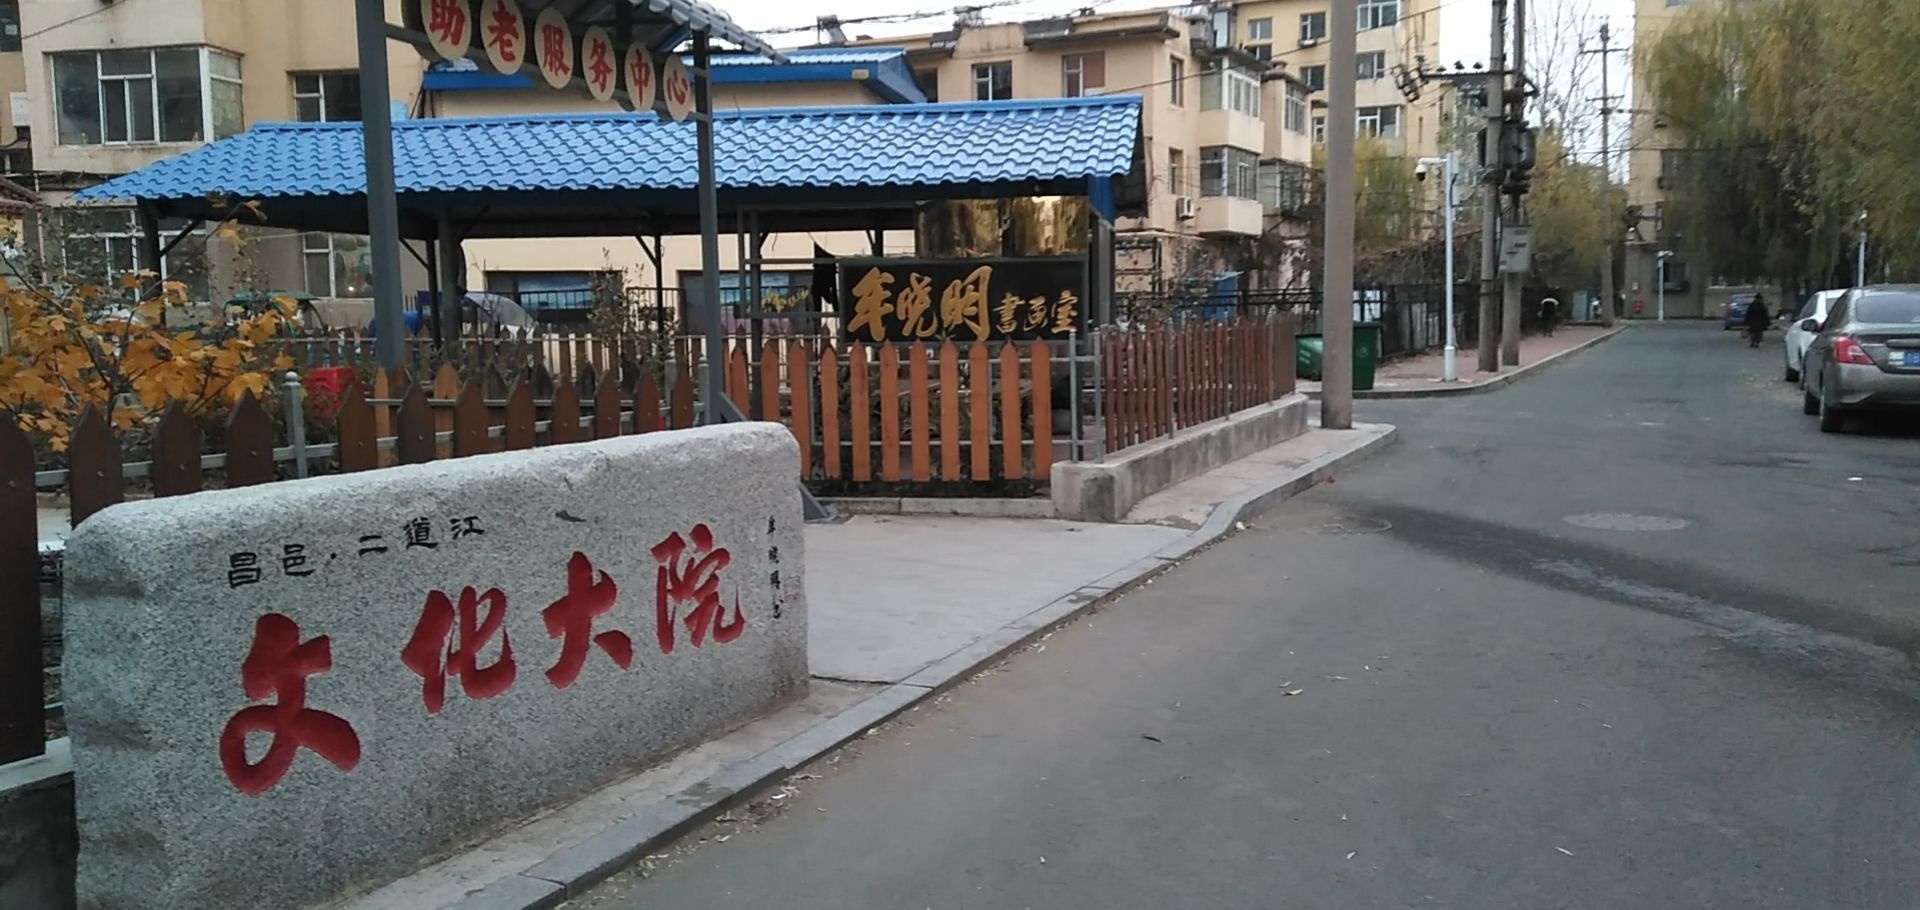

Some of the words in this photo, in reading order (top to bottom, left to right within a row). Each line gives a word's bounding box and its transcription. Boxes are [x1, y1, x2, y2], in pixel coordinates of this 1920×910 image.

[429, 0, 689, 105] 助老服务中心
[219, 522, 746, 798] 文化大院
